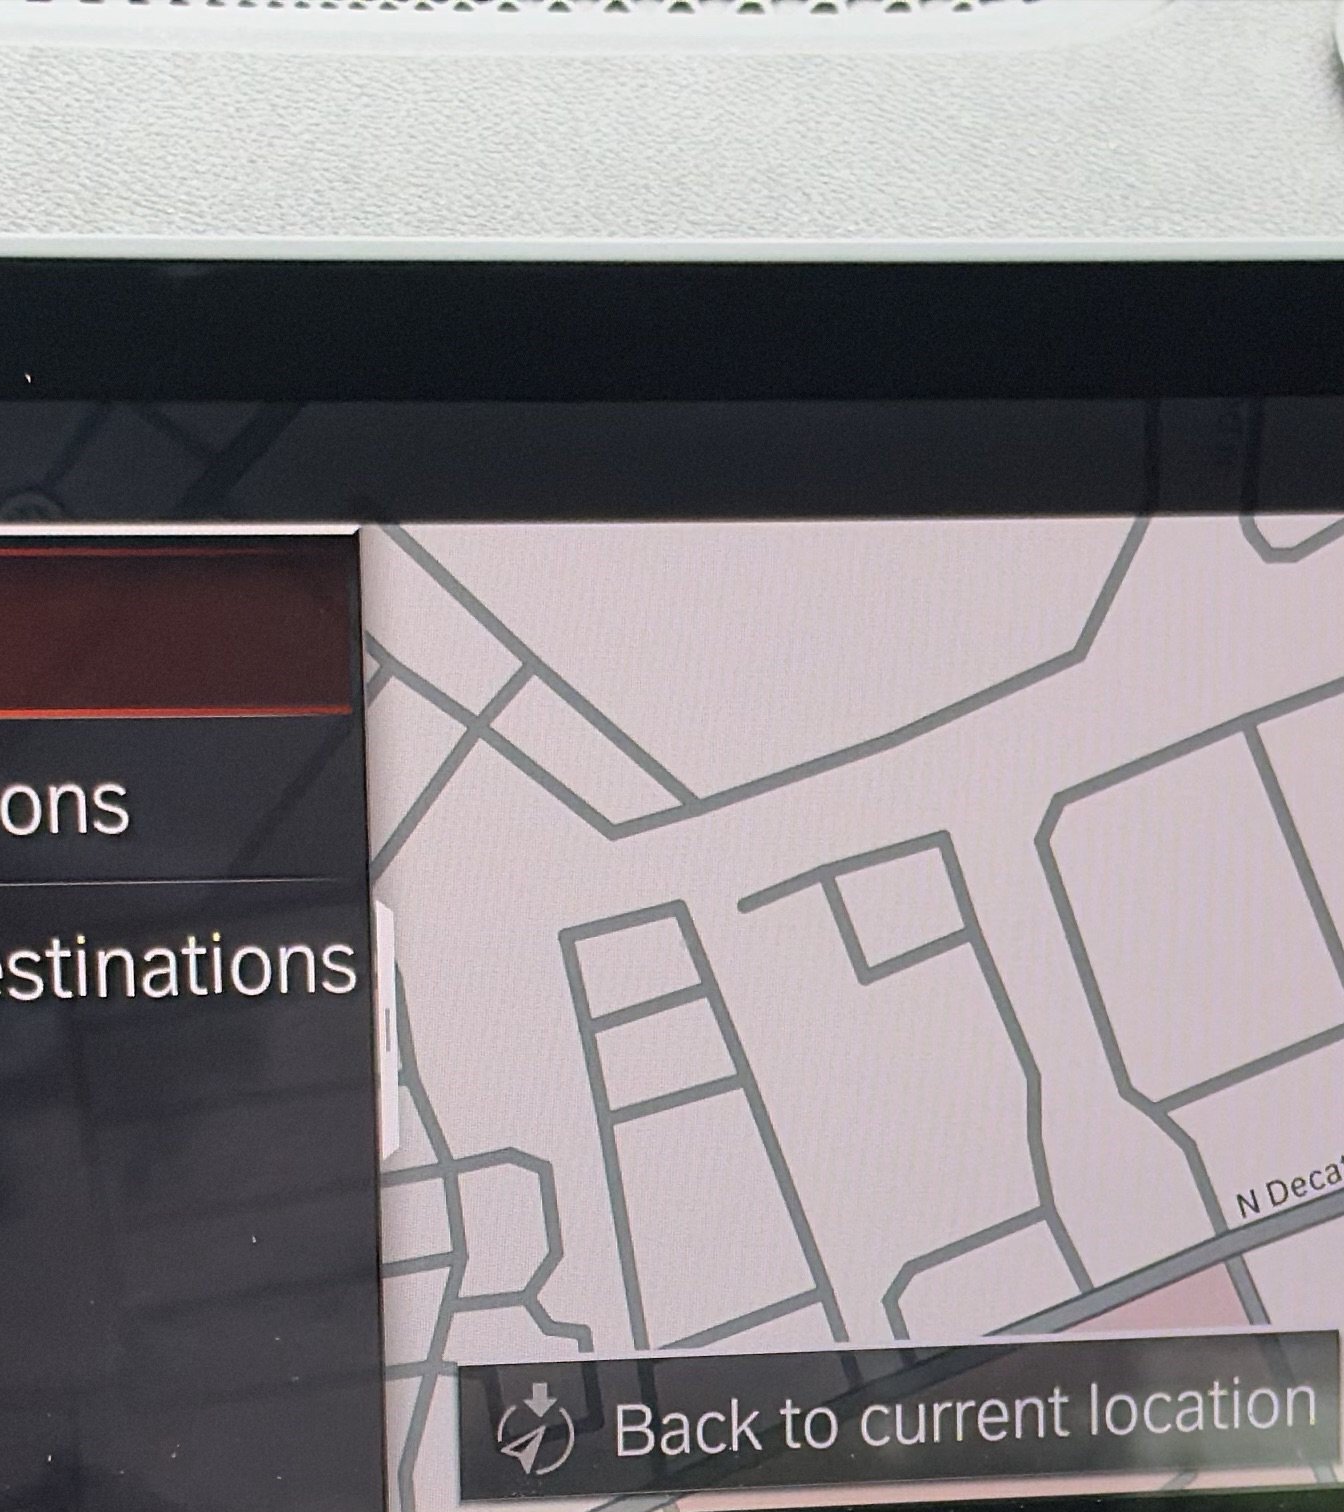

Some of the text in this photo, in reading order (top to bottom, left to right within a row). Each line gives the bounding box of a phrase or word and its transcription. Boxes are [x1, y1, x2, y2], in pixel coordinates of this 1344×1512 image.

[1235, 1190, 1261, 1221] N
[616, 1378, 1315, 1458] Back to current location
